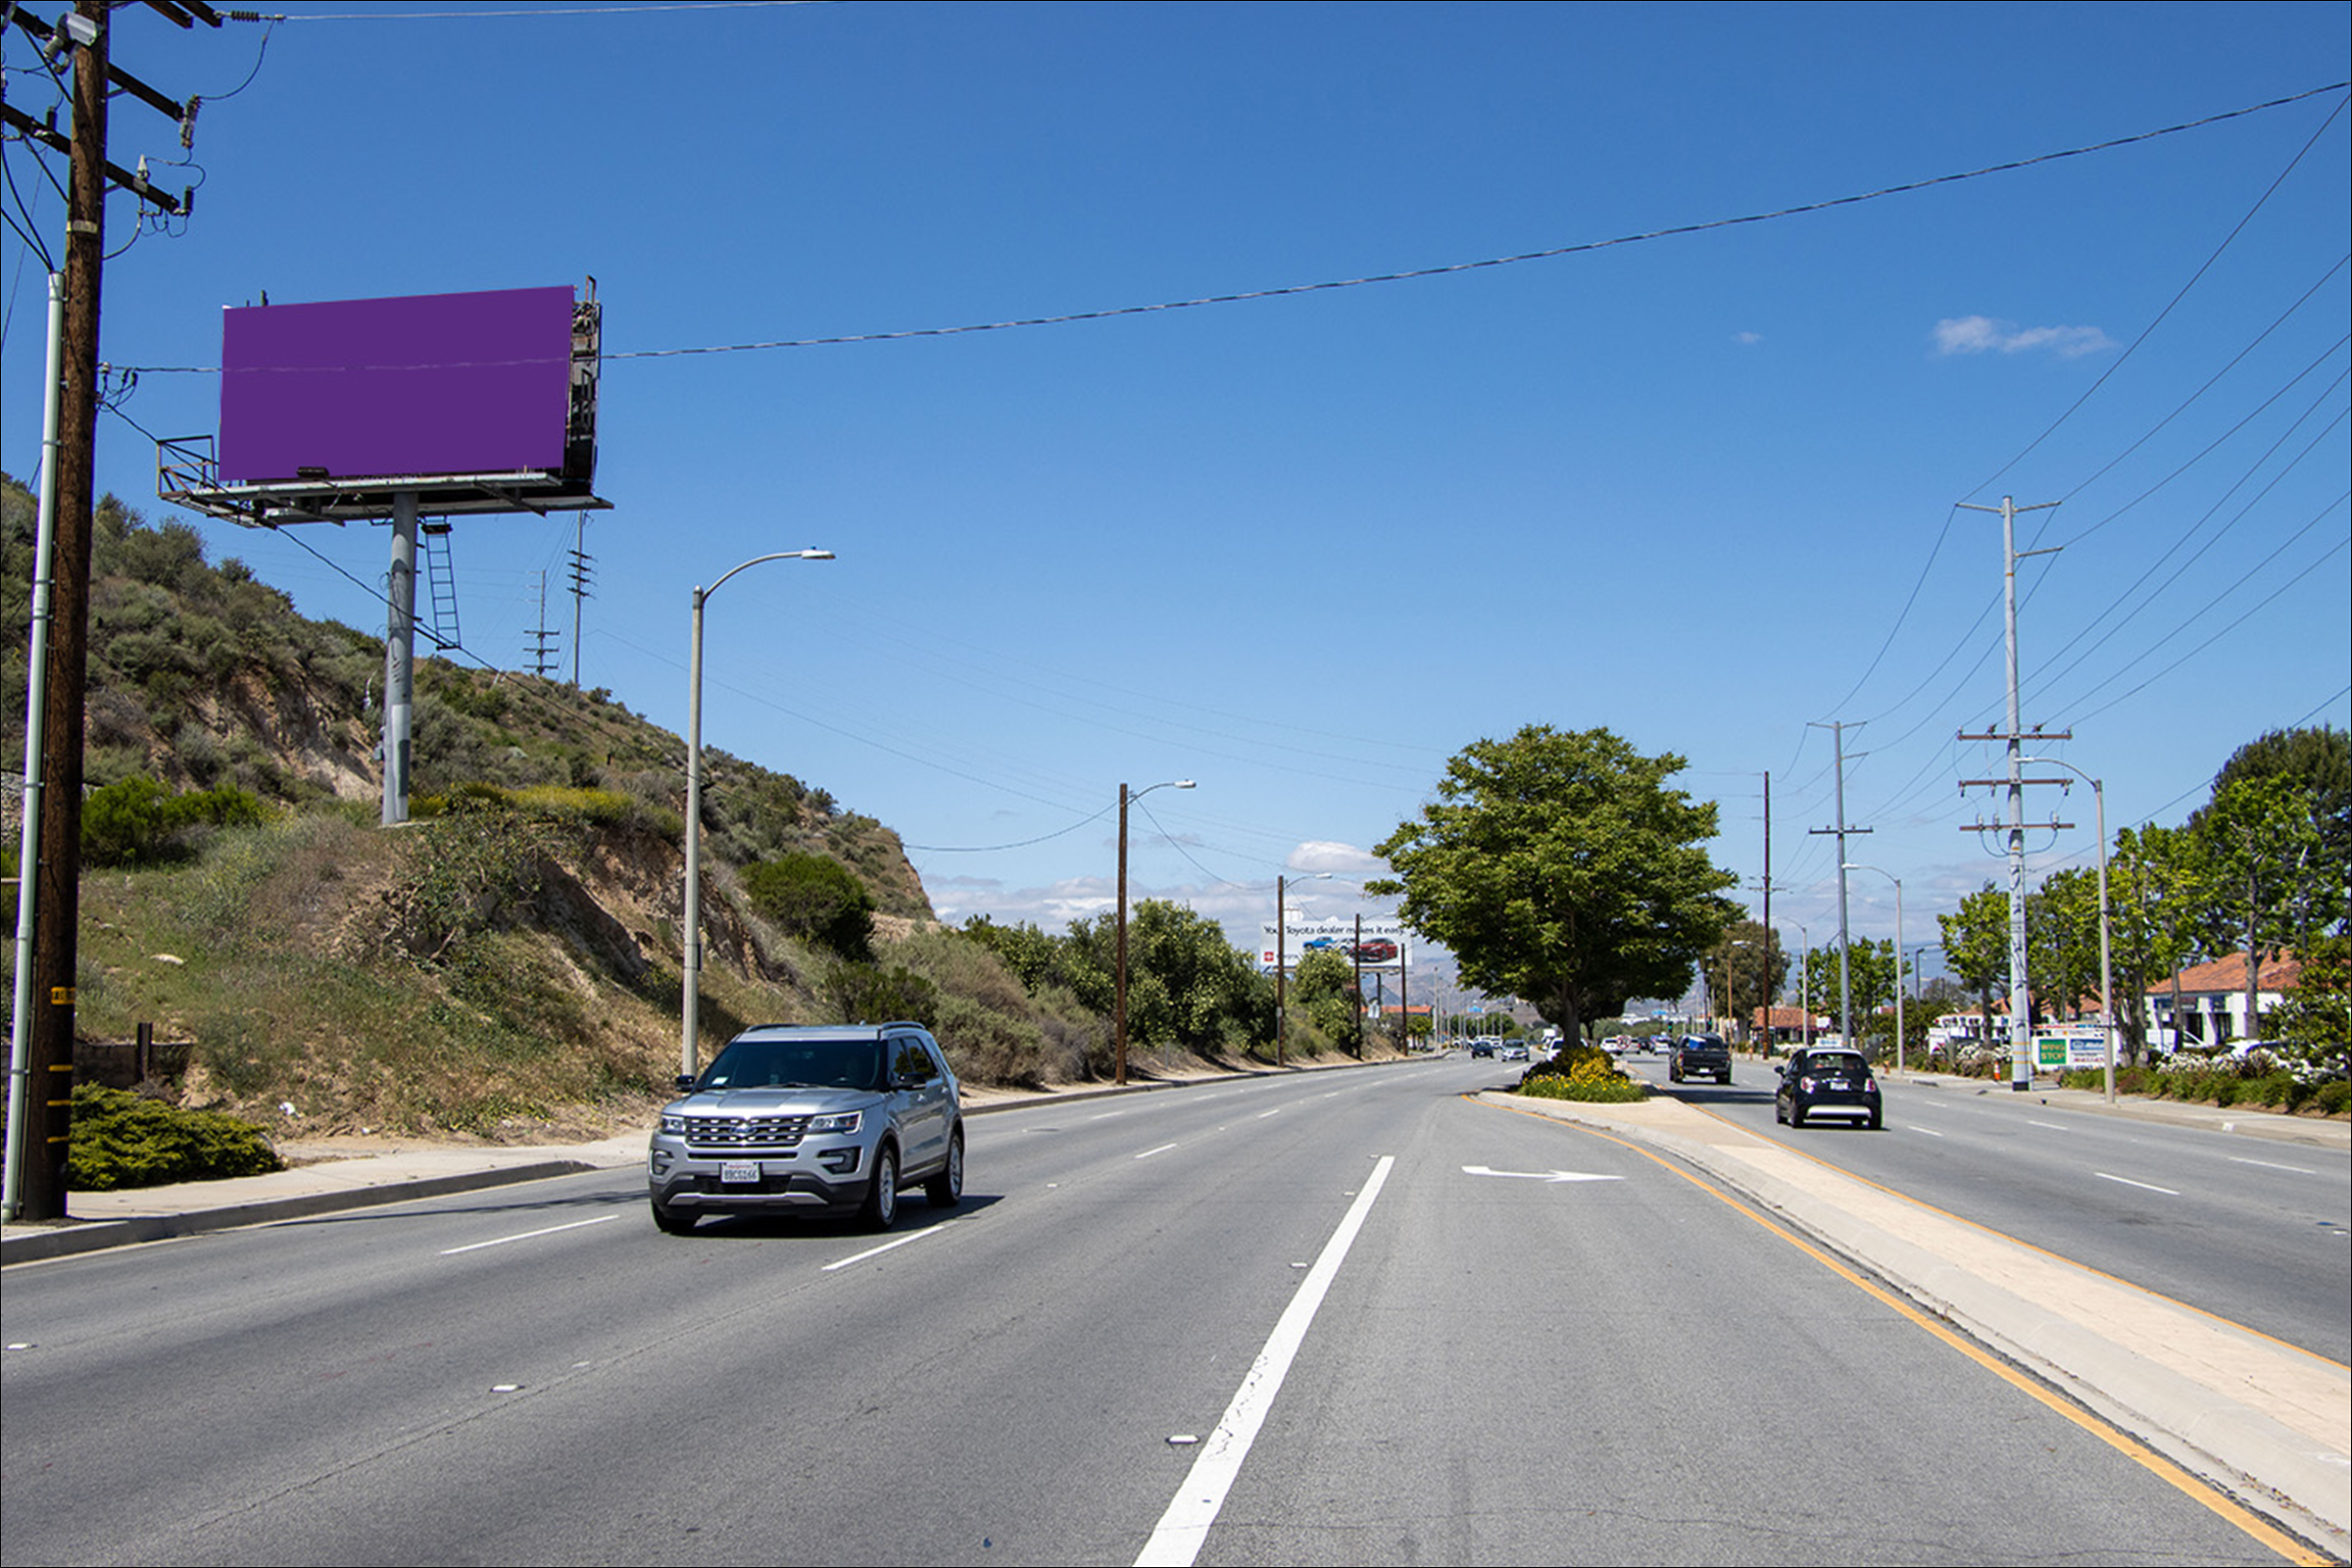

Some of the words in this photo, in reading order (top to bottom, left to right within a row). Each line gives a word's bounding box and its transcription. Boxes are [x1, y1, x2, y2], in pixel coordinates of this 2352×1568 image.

[1263, 925, 1279, 935] You
[1286, 925, 1315, 937] Toyota
[1316, 925, 1345, 935] dealer
[1347, 925, 1374, 934] mkes
[1376, 925, 1383, 934] it
